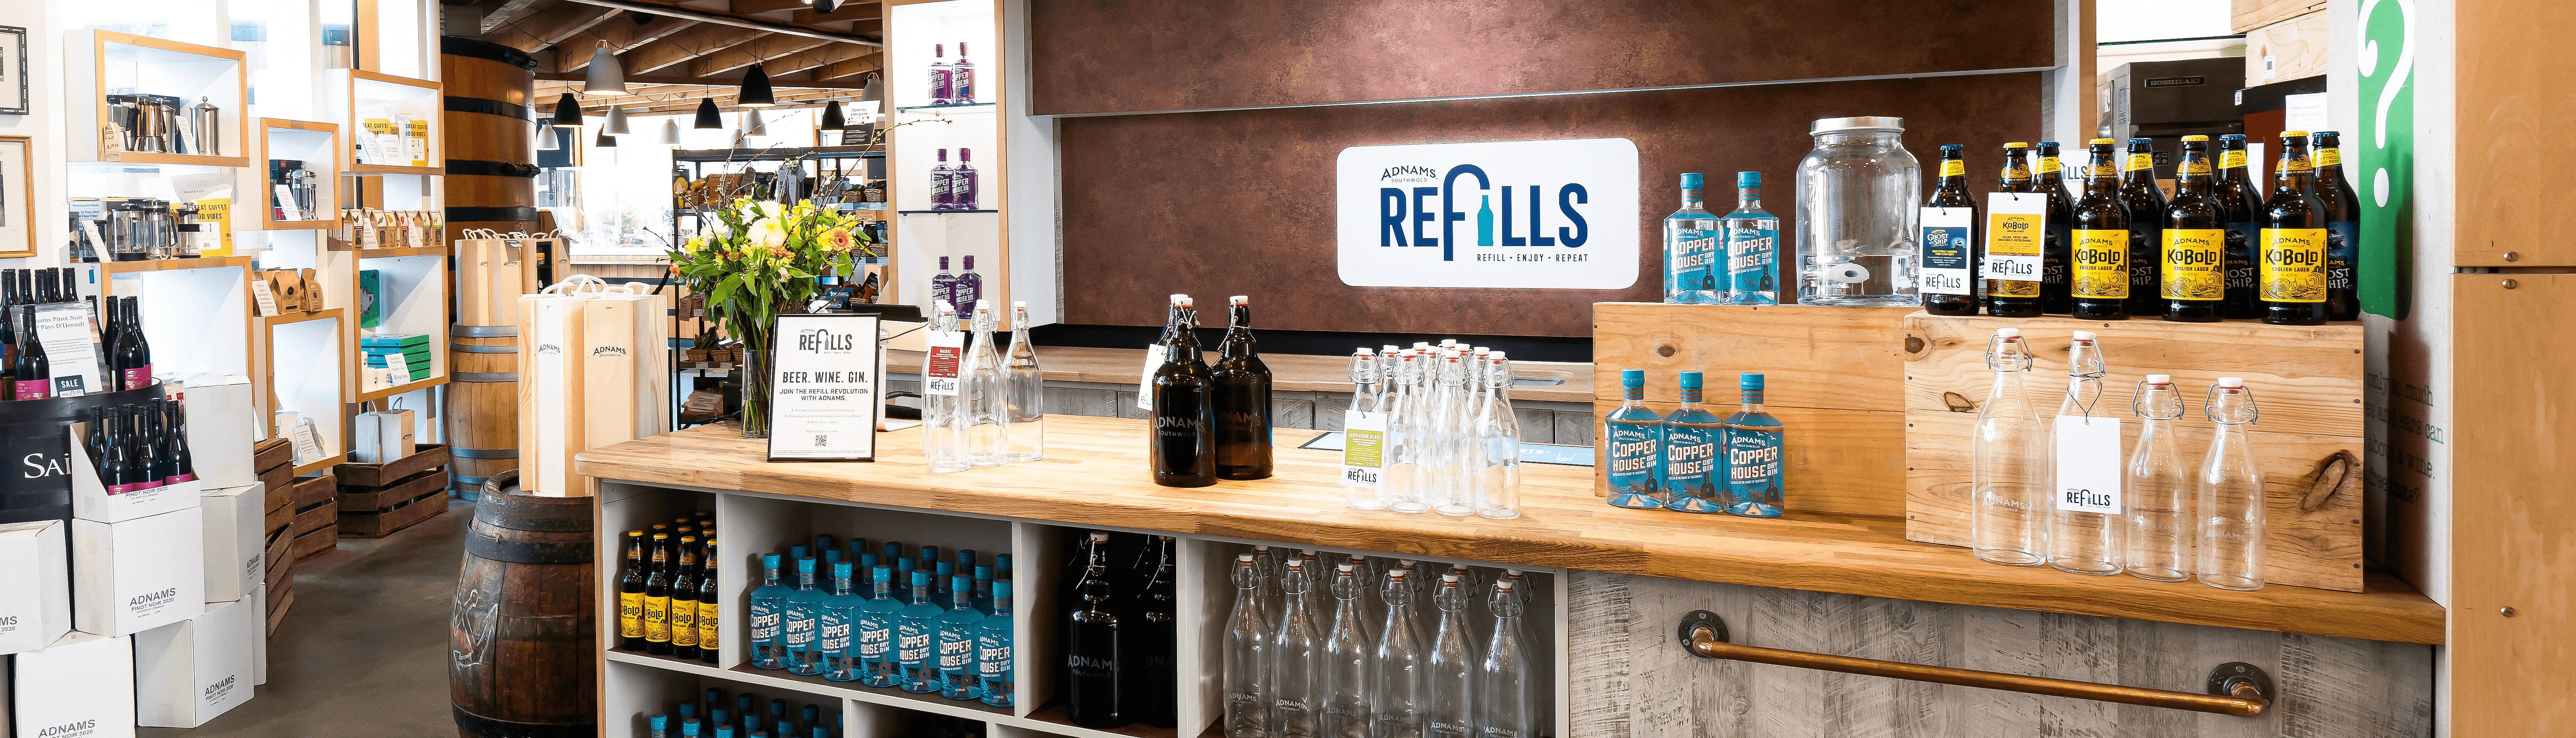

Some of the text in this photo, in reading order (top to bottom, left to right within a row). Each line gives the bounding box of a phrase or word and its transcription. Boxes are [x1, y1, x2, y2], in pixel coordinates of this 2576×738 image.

[2080, 238, 2113, 246] ADNAMS
[2174, 238, 2209, 246] ADNAMS
[2272, 238, 2310, 246] ADNAMS
[2044, 275, 2063, 284] HIP
[956, 288, 973, 297] COPPER
[539, 344, 560, 352] ADNAMS
[593, 346, 627, 355] ADNAMS
[783, 372, 867, 383] BEER. WINE. GIN.
[61, 379, 79, 388] SALE
[1154, 416, 1206, 433] ADNAMS
[2425, 424, 2444, 444] can
[1612, 439, 1656, 458] COPPER
[1668, 443, 1713, 461] COPPER
[1647, 453, 1657, 462] DRY
[1730, 446, 1778, 465] COPPER
[1613, 457, 1646, 471] HOUSE
[1647, 460, 1657, 468] GIN
[1702, 457, 1713, 466] DRY
[1767, 461, 1778, 469] DRY
[1668, 461, 1702, 475] HOUSE
[1703, 464, 1713, 472] GIN
[1731, 465, 1766, 479] HOUSE
[1767, 467, 1778, 476] GIN
[130, 588, 176, 606] ADNAMS
[751, 613, 780, 627] COPPER
[787, 618, 815, 632] COPPER
[822, 624, 849, 638] COPPER
[860, 628, 889, 643] COPPER
[899, 634, 929, 648] COPPER
[940, 640, 971, 654] COPPER
[900, 649, 919, 660] HOUSE
[980, 646, 1010, 660] COPPER
[940, 655, 961, 666] HOUSE
[1068, 654, 1120, 671] ADNAMS
[980, 661, 999, 672] HOUSE
[1073, 669, 1110, 678] SOUTHWOLD
[205, 674, 235, 697] ADNAMS
[206, 688, 225, 701] PINOT NOIR
[1228, 692, 1257, 702] ADNAMS
[1276, 699, 1307, 709] ADNAMS
[39, 719, 95, 738] ADNAMS
[1431, 721, 1463, 732] ADNAMS
